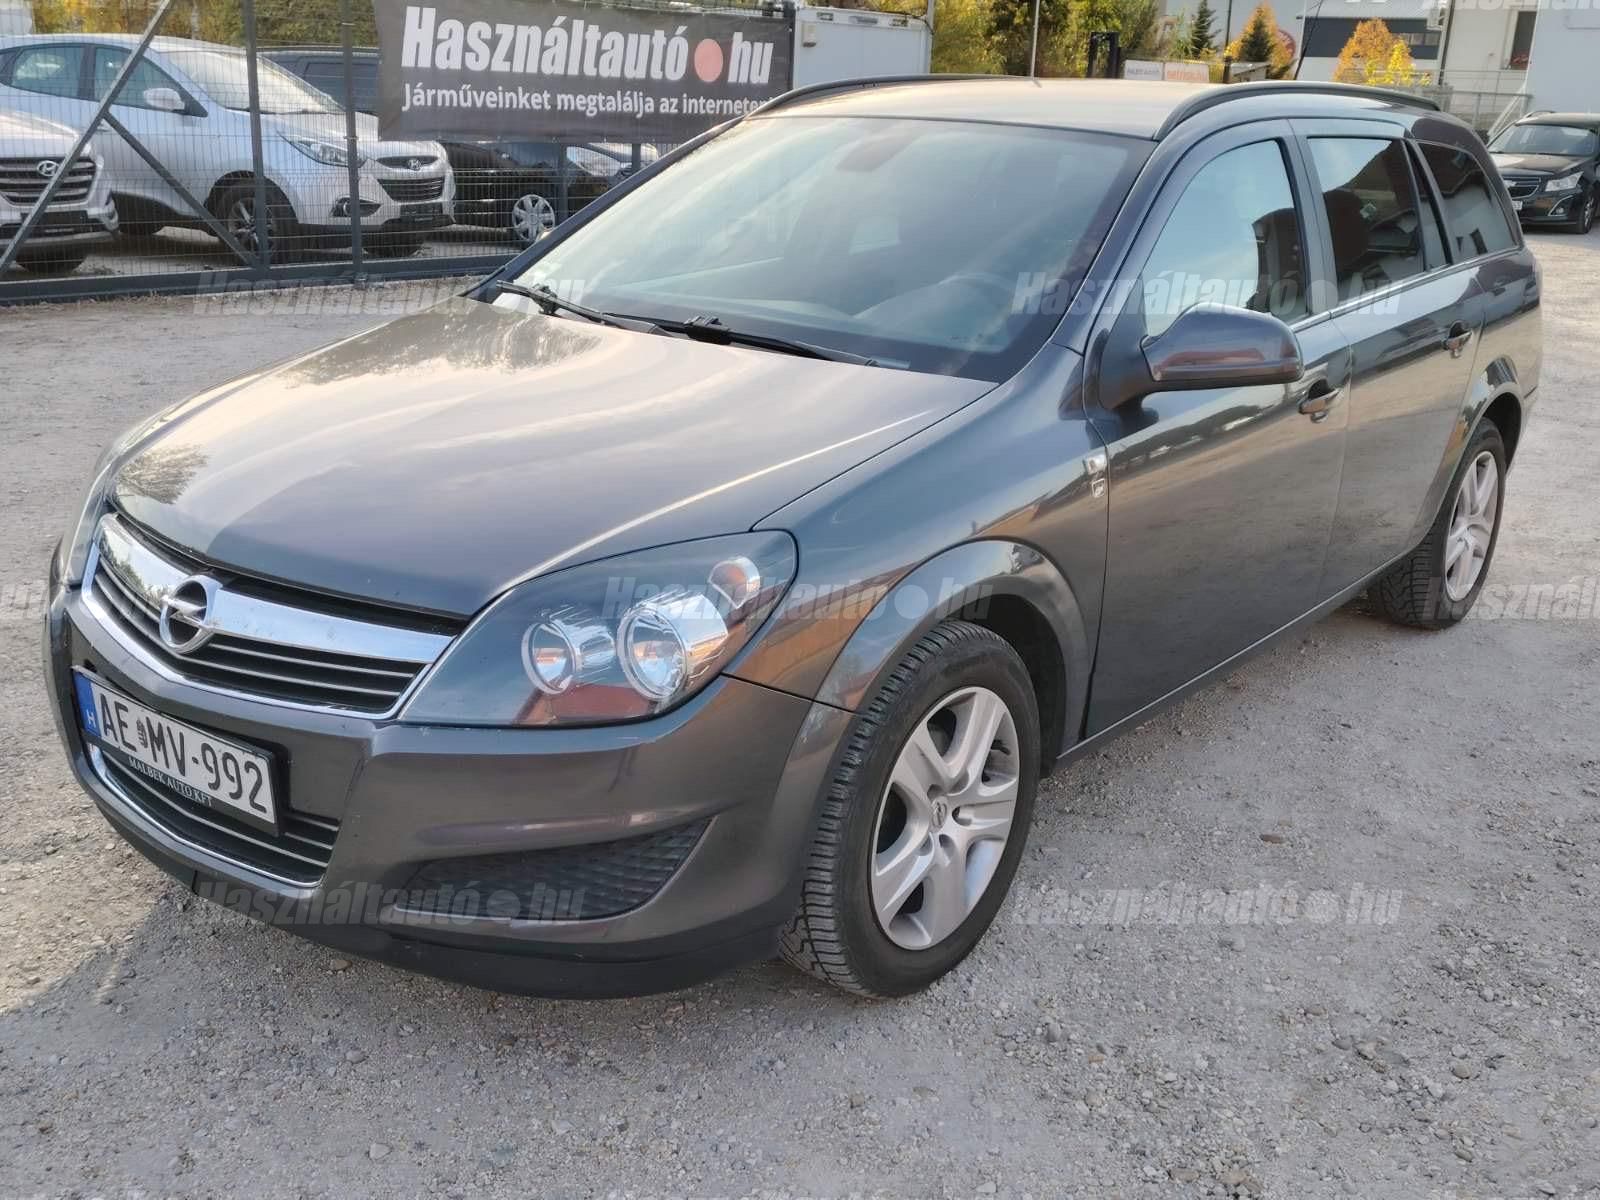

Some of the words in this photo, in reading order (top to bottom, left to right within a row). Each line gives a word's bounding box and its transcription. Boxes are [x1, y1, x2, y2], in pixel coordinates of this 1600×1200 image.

[402, 83, 551, 112] Járműveinket
[557, 86, 655, 119] megtalálja
[659, 96, 678, 113] az
[167, 776, 193, 797] AUTO
